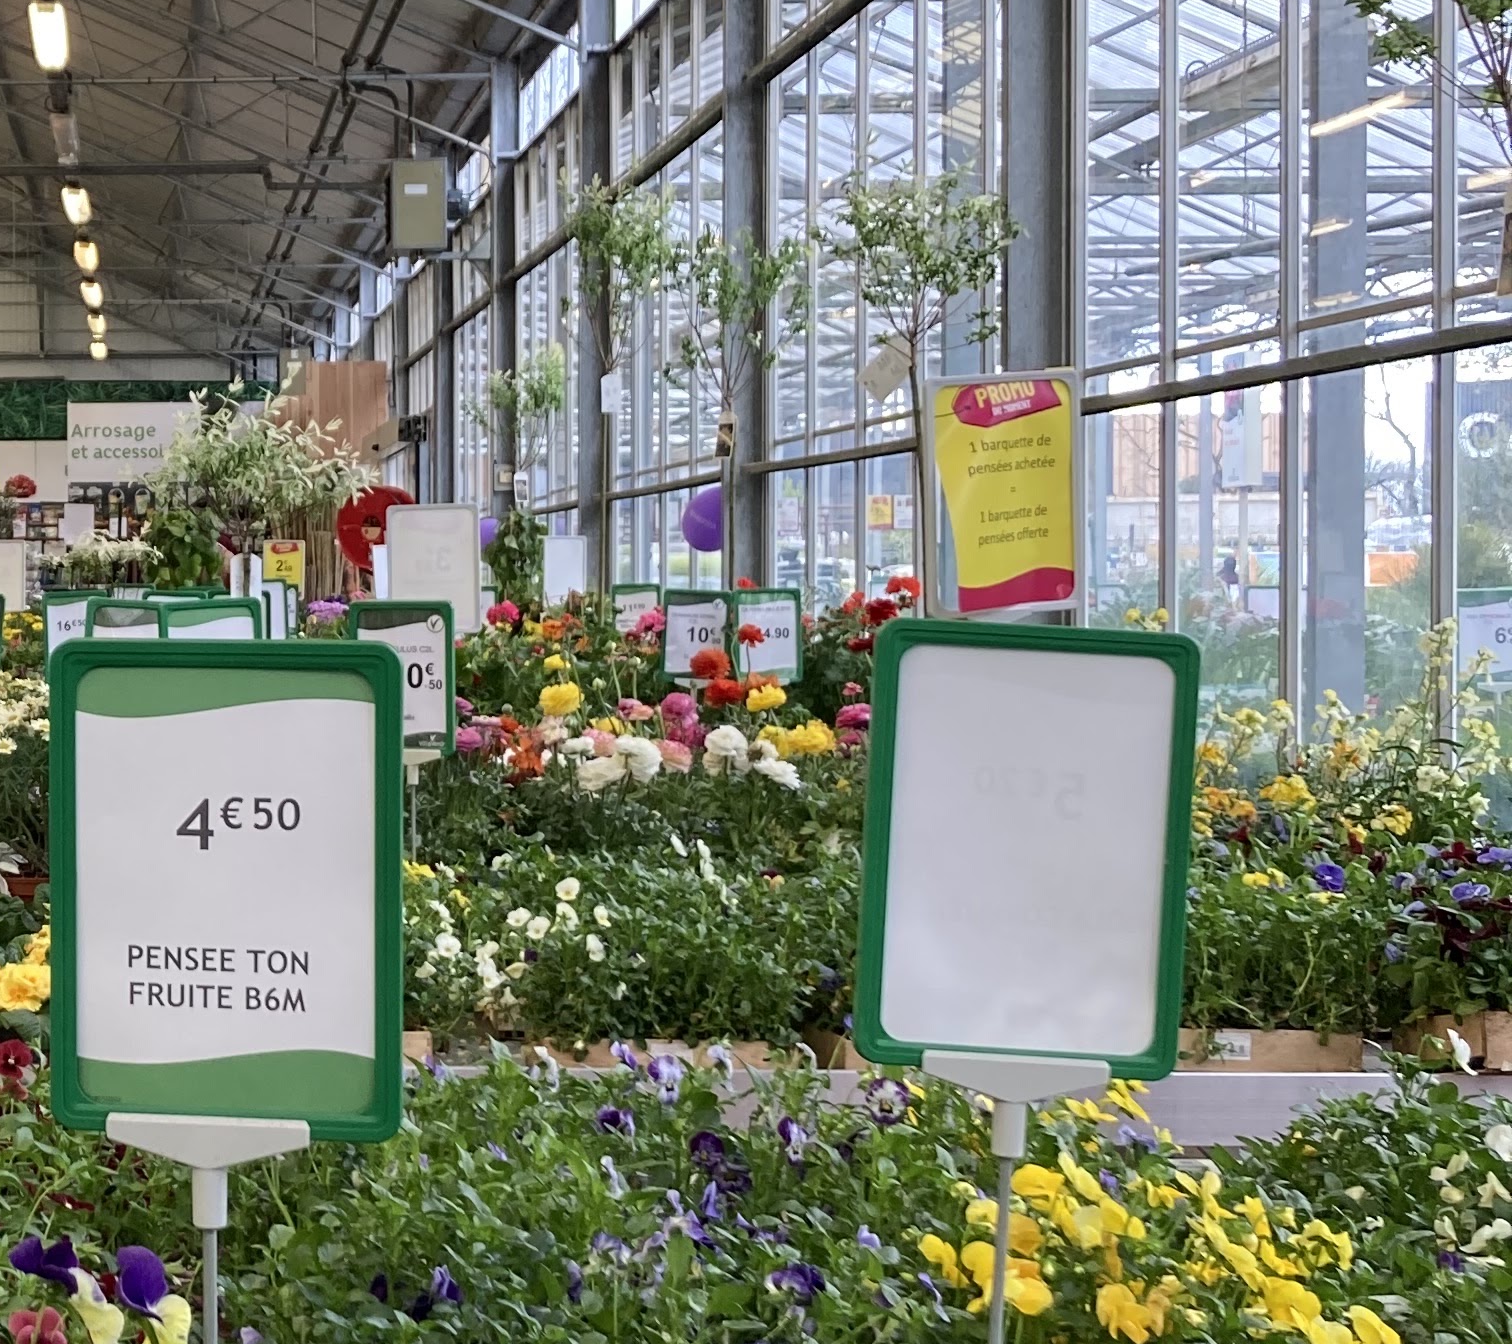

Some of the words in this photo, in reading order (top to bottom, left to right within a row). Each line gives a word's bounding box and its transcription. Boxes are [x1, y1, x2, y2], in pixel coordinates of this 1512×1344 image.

[71, 424, 156, 441] Arrosage
[71, 445, 87, 459] et
[93, 443, 164, 459] accessoi
[969, 442, 977, 453] 1
[981, 435, 1034, 453] barquette
[1036, 434, 1052, 447] de
[968, 460, 1013, 478] pensées
[1014, 457, 1056, 470] achetée
[980, 512, 986, 523] 1
[988, 508, 1033, 525] barquette
[1035, 505, 1048, 516] de
[978, 531, 1015, 548] pensées
[1017, 526, 1049, 540] offerte
[127, 943, 236, 974] PENSEE
[246, 949, 310, 976] TON
[128, 981, 233, 1010] FRUITE
[245, 986, 307, 1014] B6M
